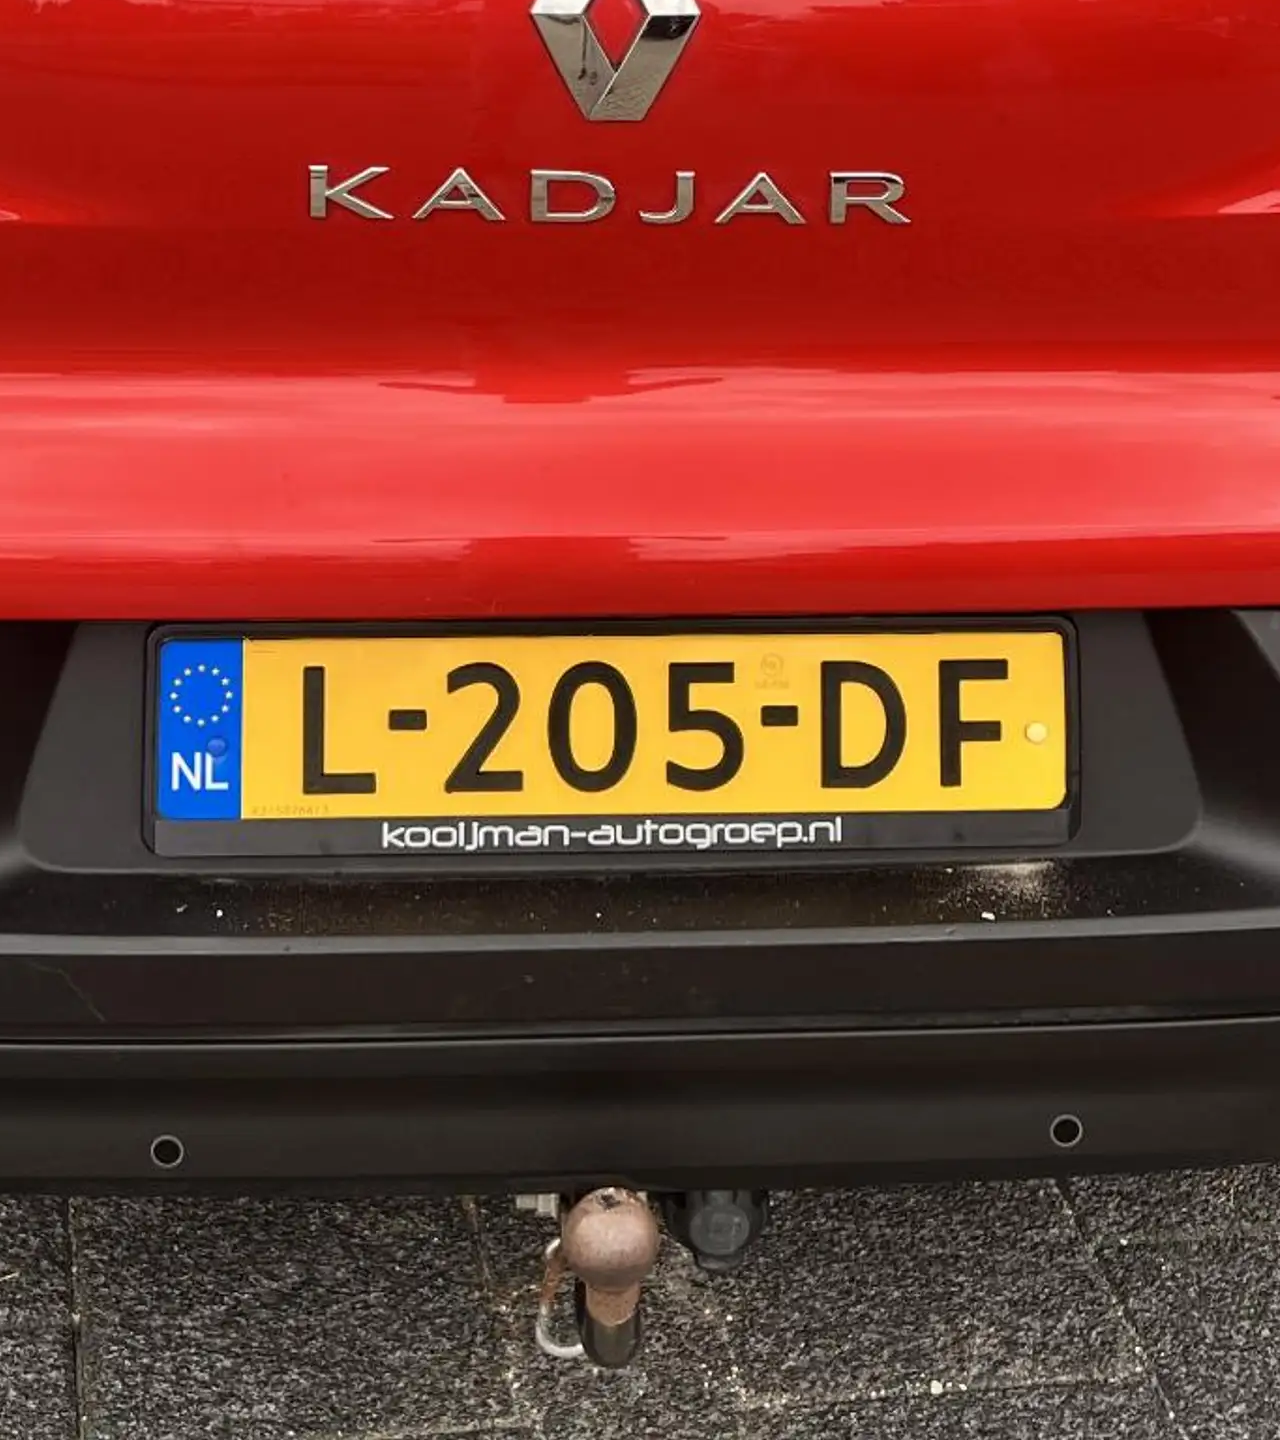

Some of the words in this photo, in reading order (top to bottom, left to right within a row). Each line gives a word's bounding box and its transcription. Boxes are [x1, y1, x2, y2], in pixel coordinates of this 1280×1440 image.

[307, 163, 913, 227] KADJAR
[301, 658, 1011, 795] L-205-DF
[170, 751, 229, 792] NL
